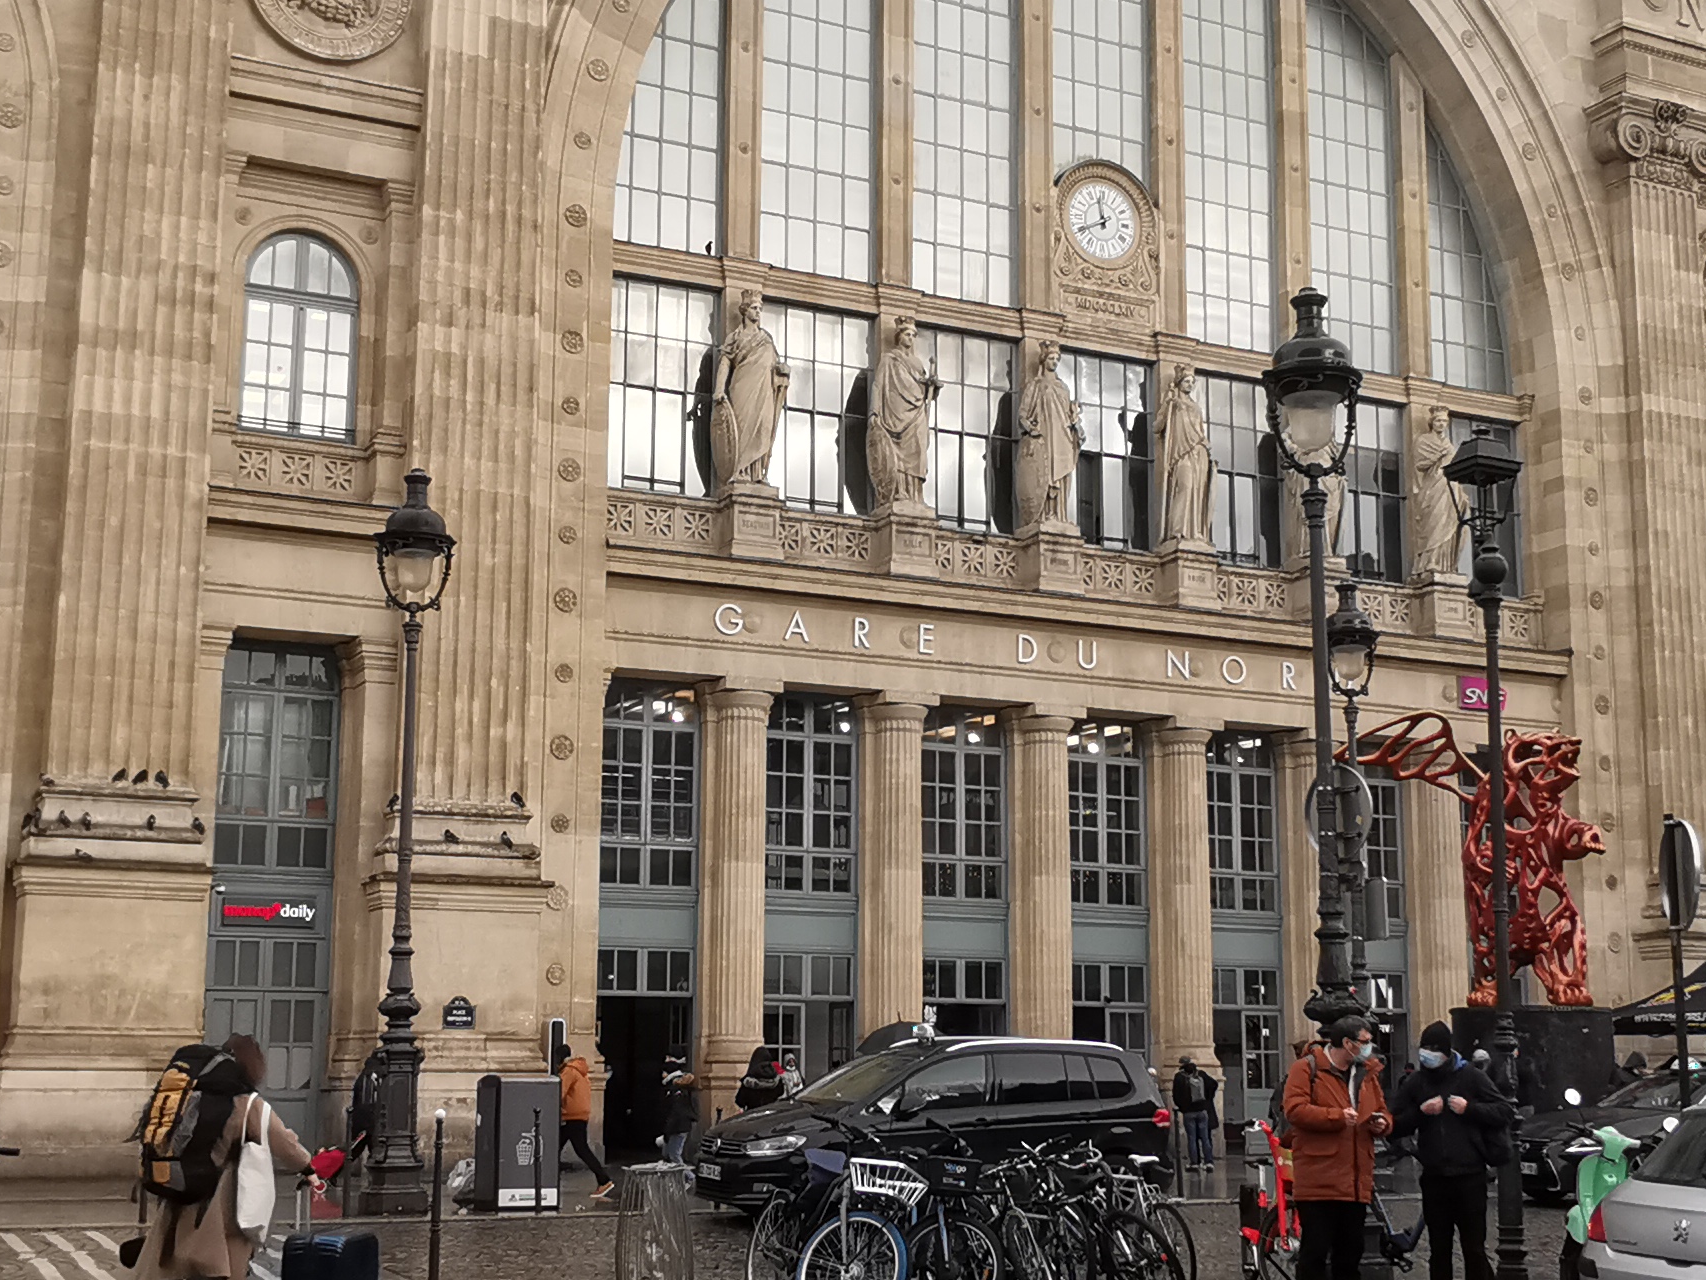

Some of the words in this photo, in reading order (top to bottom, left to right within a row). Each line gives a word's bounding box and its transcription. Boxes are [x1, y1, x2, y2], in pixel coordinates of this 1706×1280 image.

[714, 603, 935, 655] GARE
[1017, 633, 1098, 670] DU
[1166, 648, 1351, 696] NOR
